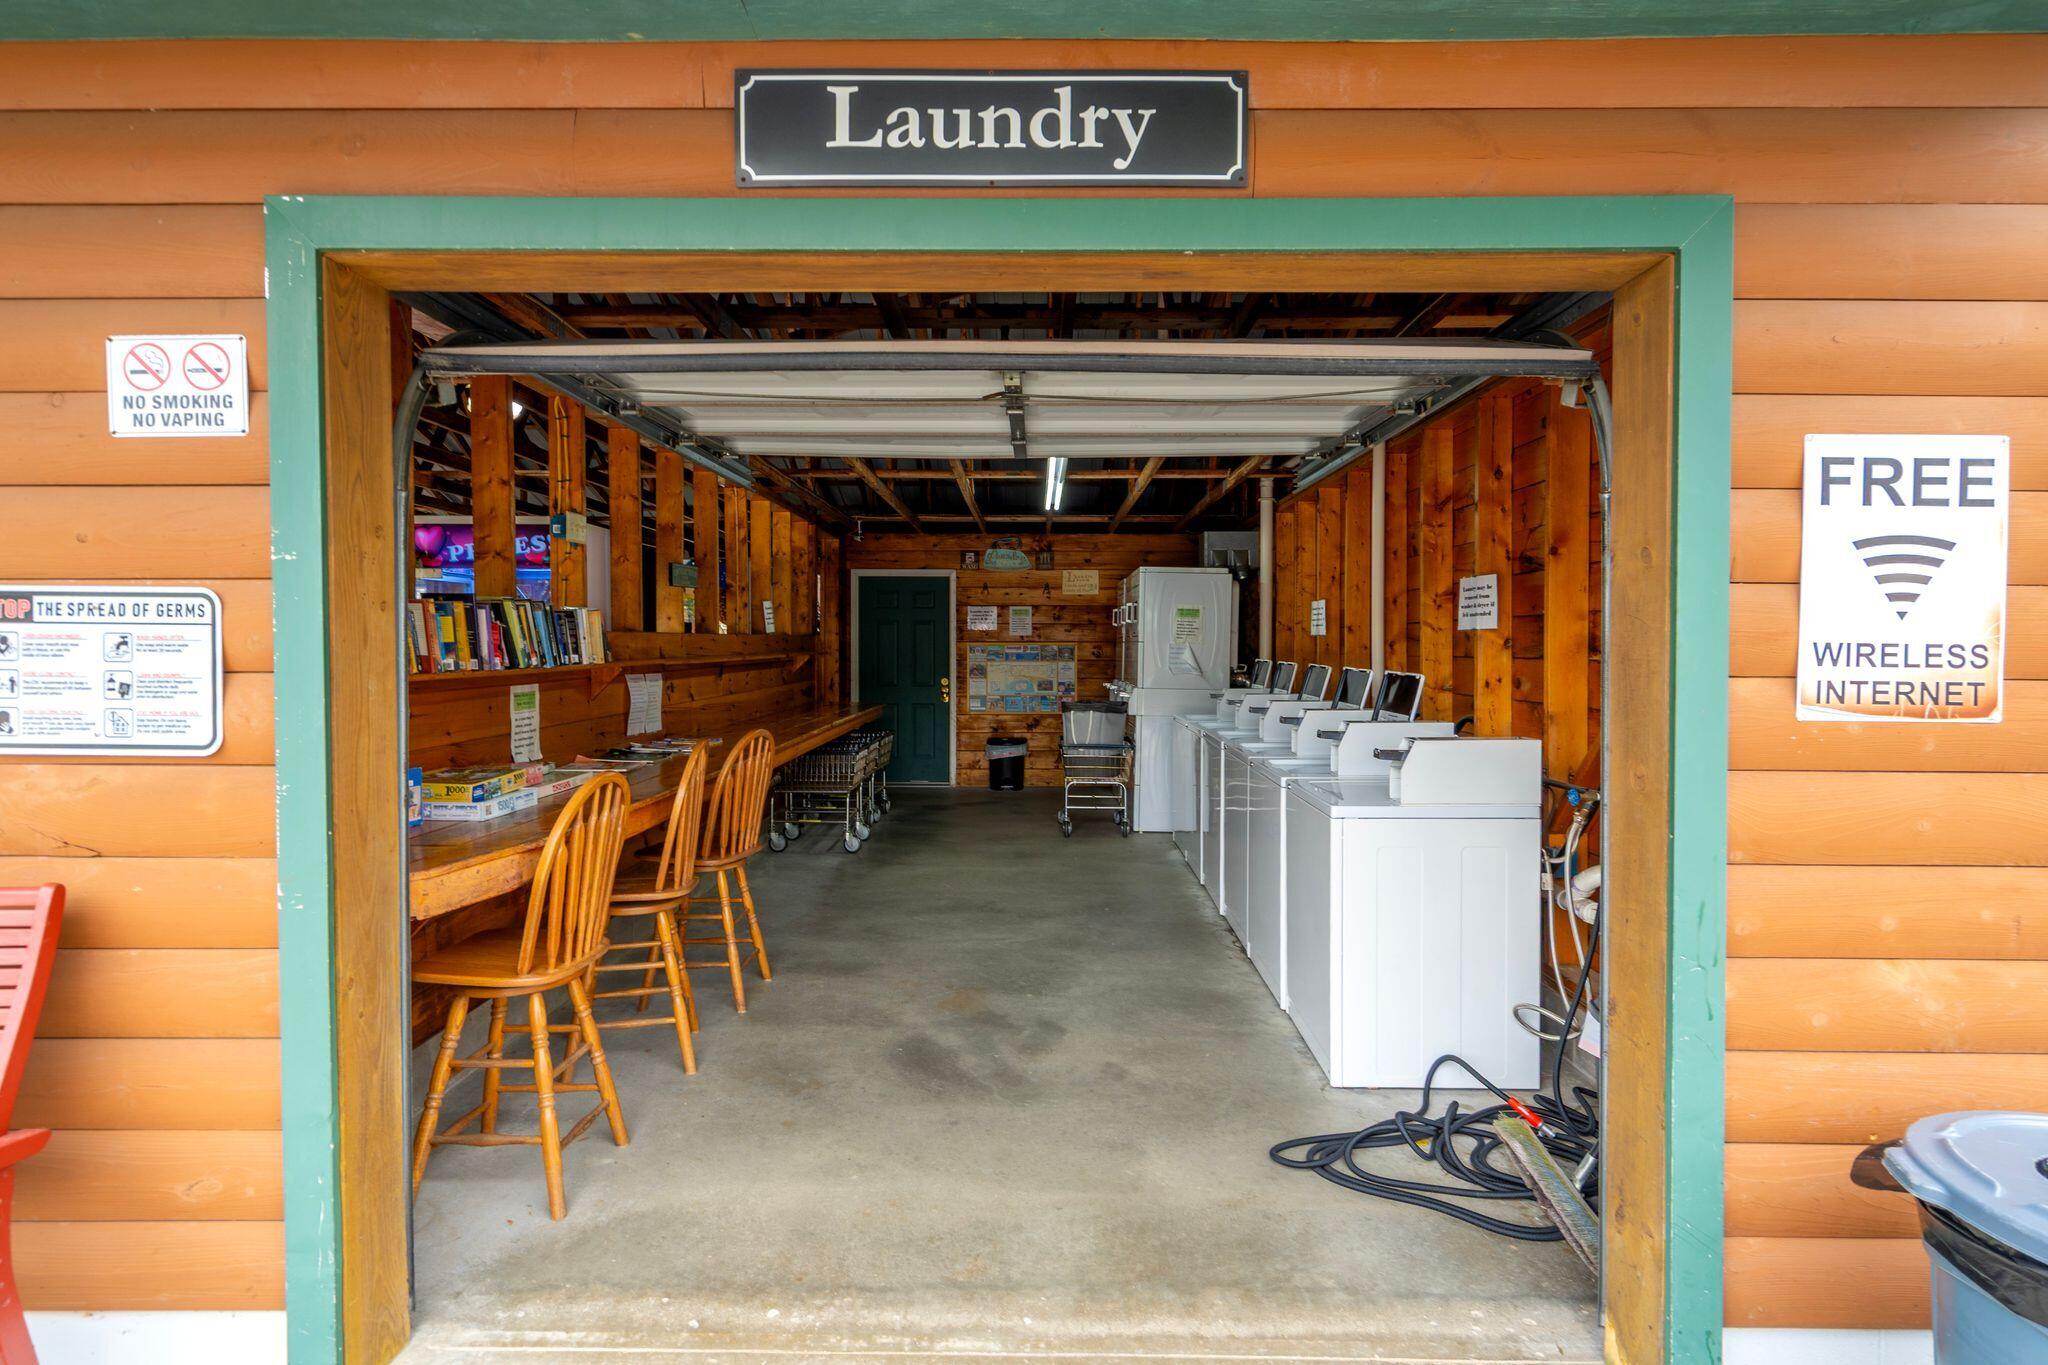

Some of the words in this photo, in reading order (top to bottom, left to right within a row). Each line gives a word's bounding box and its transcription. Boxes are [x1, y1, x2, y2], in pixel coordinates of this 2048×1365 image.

[825, 84, 1157, 170] Laundry
[122, 395, 146, 410] NO
[152, 394, 233, 409] SMOKING
[132, 413, 156, 428] NO
[160, 412, 225, 427] VAPING
[1820, 456, 1996, 508] FREE
[36, 601, 62, 616] THE
[67, 602, 126, 617] SPREAD
[132, 603, 150, 617] OF
[156, 603, 205, 618] GERMS
[1813, 642, 1989, 669] WIRELESS
[1815, 680, 1986, 707] INTERNET
[445, 786, 466, 797] 1000
